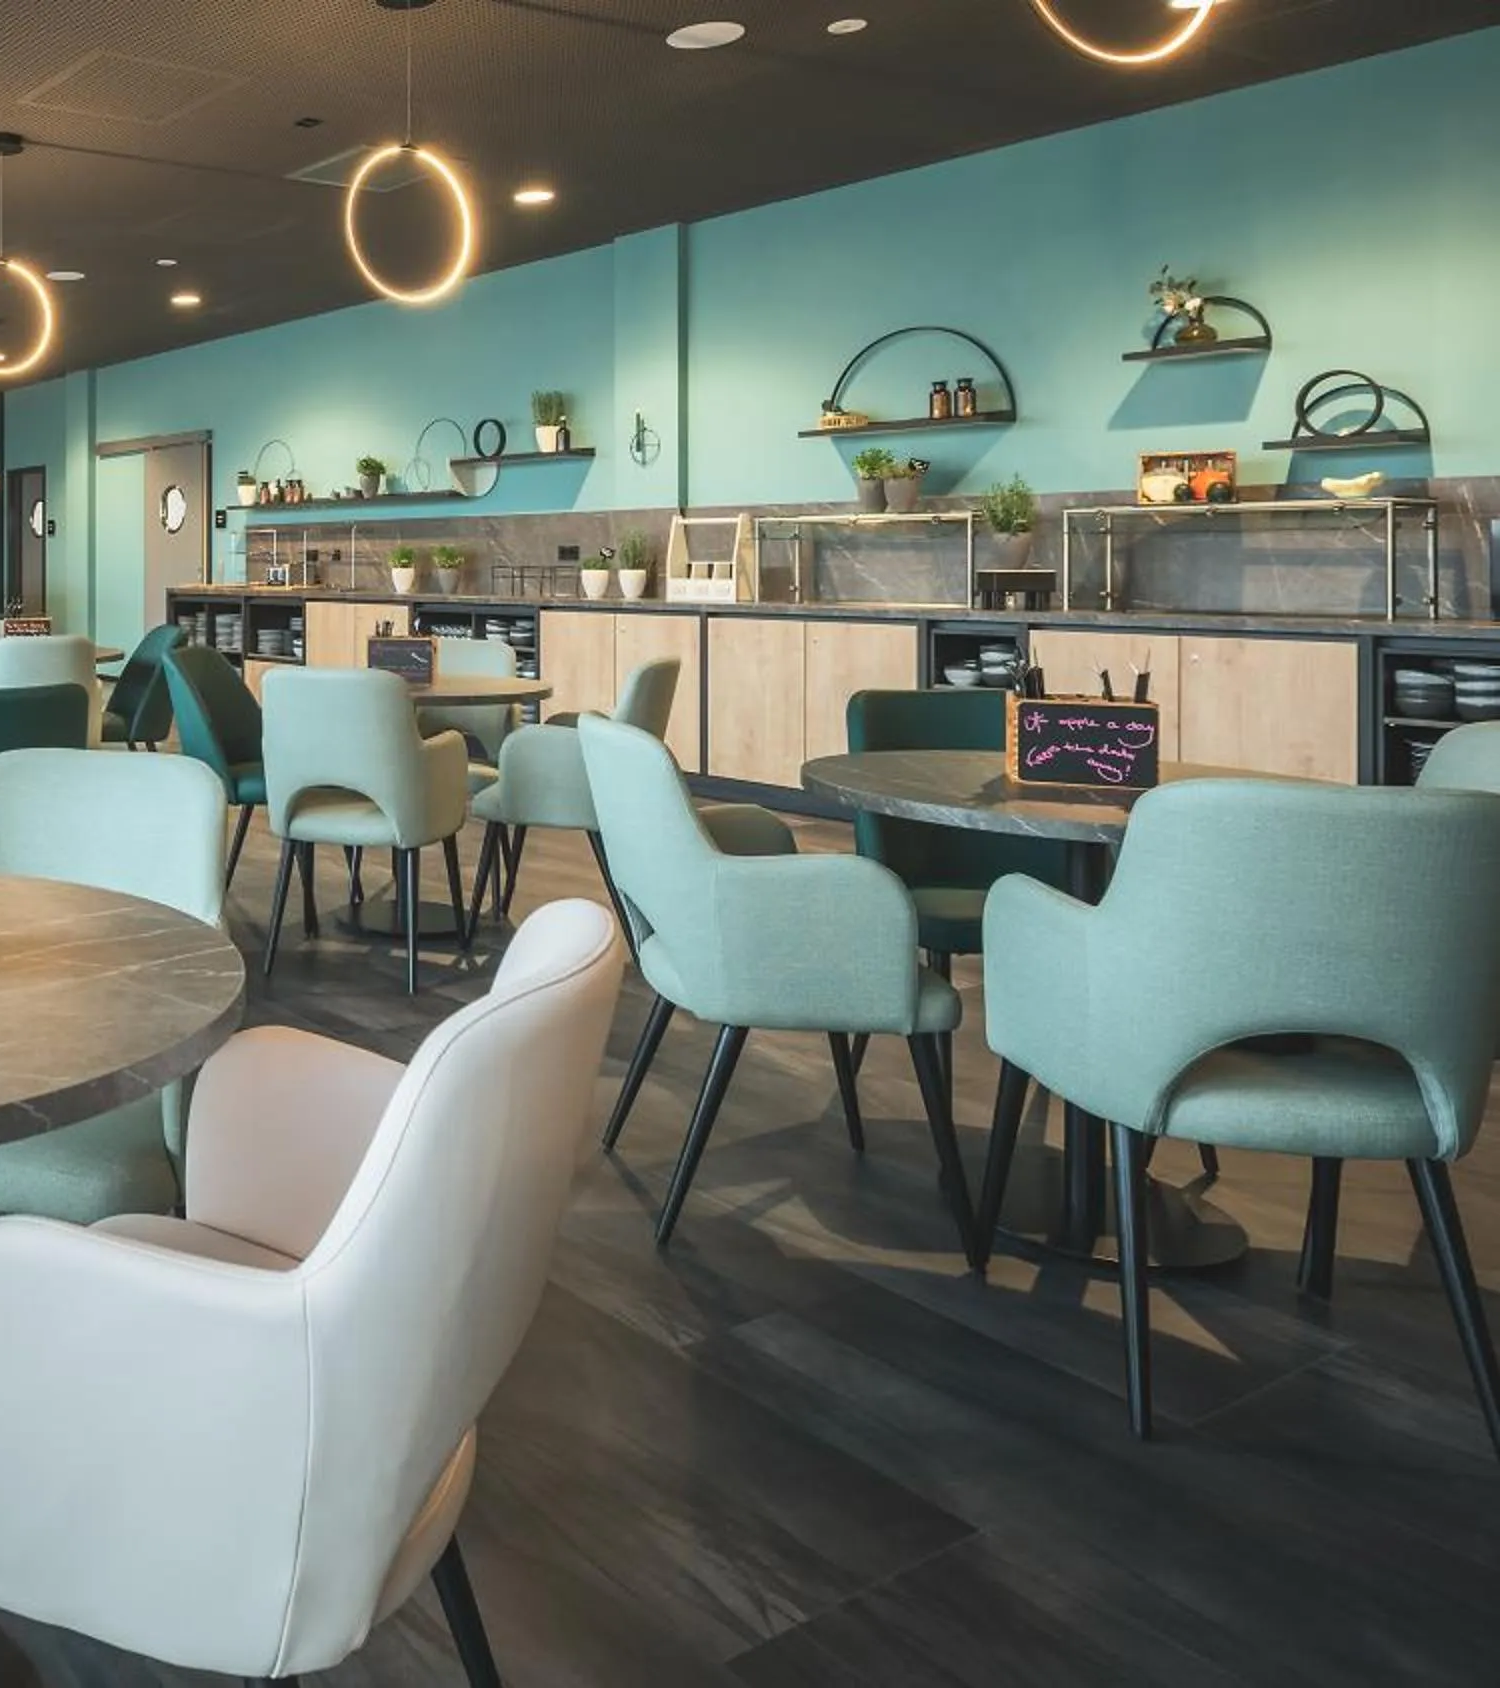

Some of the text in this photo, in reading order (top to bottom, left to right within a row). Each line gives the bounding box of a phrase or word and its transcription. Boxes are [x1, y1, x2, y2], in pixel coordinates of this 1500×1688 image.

[1059, 717, 1100, 730] apple
[1107, 721, 1119, 729] a
[1117, 723, 1155, 749] day
